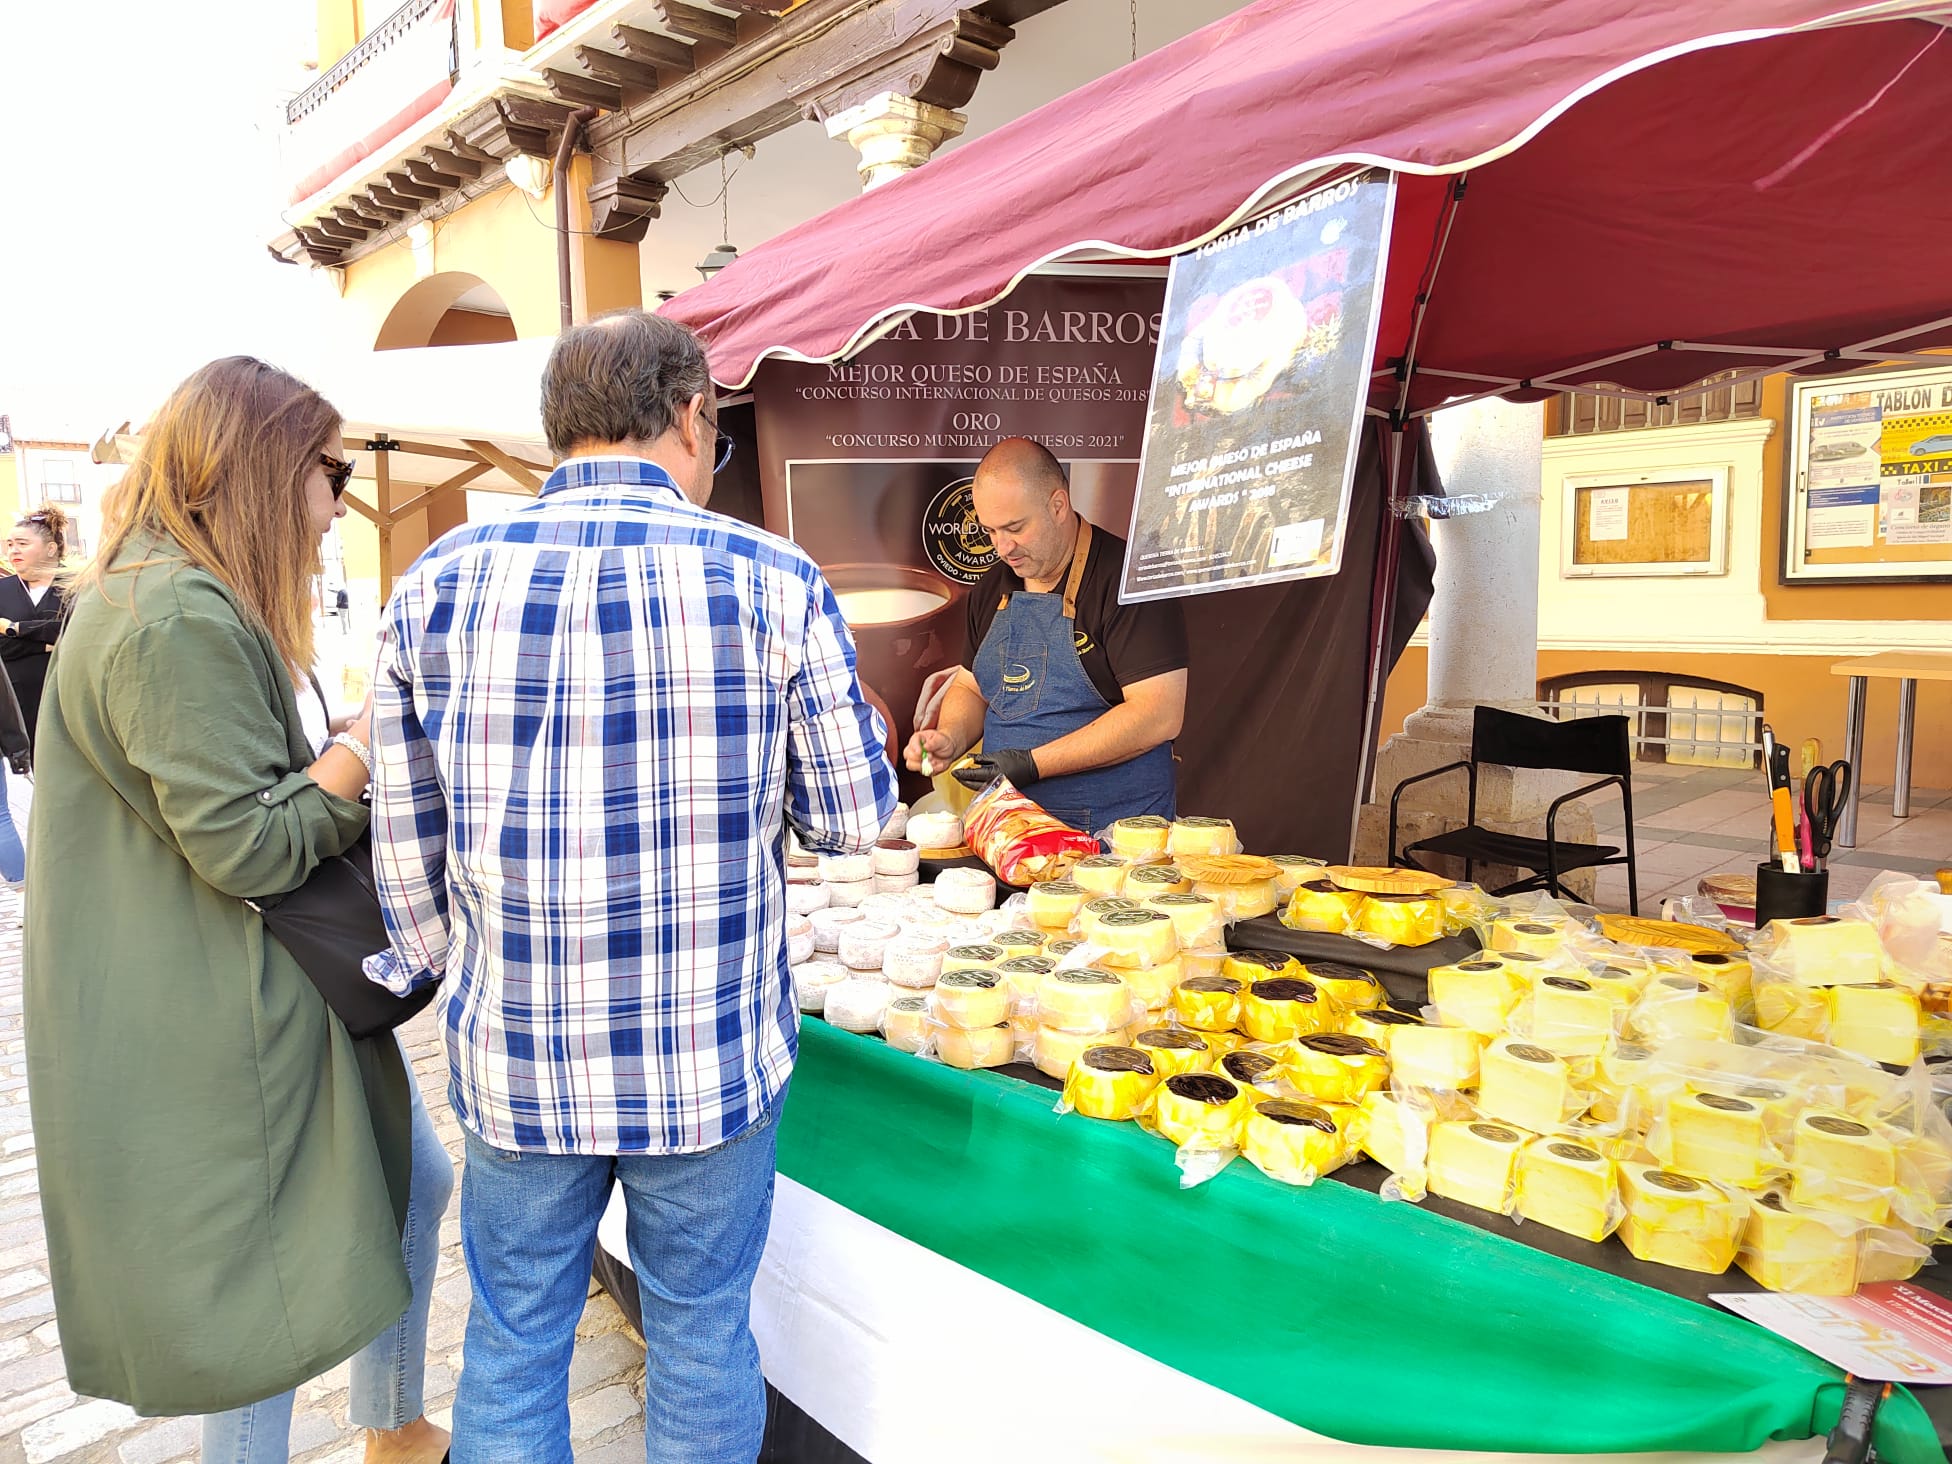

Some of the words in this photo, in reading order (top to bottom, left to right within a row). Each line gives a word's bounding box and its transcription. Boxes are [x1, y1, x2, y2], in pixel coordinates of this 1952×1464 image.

[1195, 226, 1250, 260] TORTA
[1254, 212, 1281, 237] DE
[1282, 177, 1360, 225] BARROS
[934, 309, 990, 343] DE
[1003, 309, 1163, 346] BARROS
[826, 364, 905, 386] MEJOR
[911, 364, 992, 387] QUESO
[998, 366, 1029, 385] DE
[1037, 362, 1123, 385] ESPAÑA
[896, 386, 1020, 401] INTERNACIONAL
[1024, 388, 1045, 401] DE
[1049, 388, 1111, 403] QUESOS
[953, 412, 1001, 431] ORO
[924, 434, 993, 447] MUNDIAL
[1170, 459, 1208, 477] MEJOR
[1209, 448, 1249, 468] QUESO
[1250, 442, 1269, 458] DE
[1270, 430, 1322, 454] ESPAÑA
[1265, 453, 1314, 475] CHEESE
[1902, 462, 1939, 474] TAXI
[1188, 491, 1240, 513] AWARDS
[928, 522, 978, 536] WORLD
[936, 554, 959, 576] OVIEDO
[955, 550, 999, 565] AWARDS
